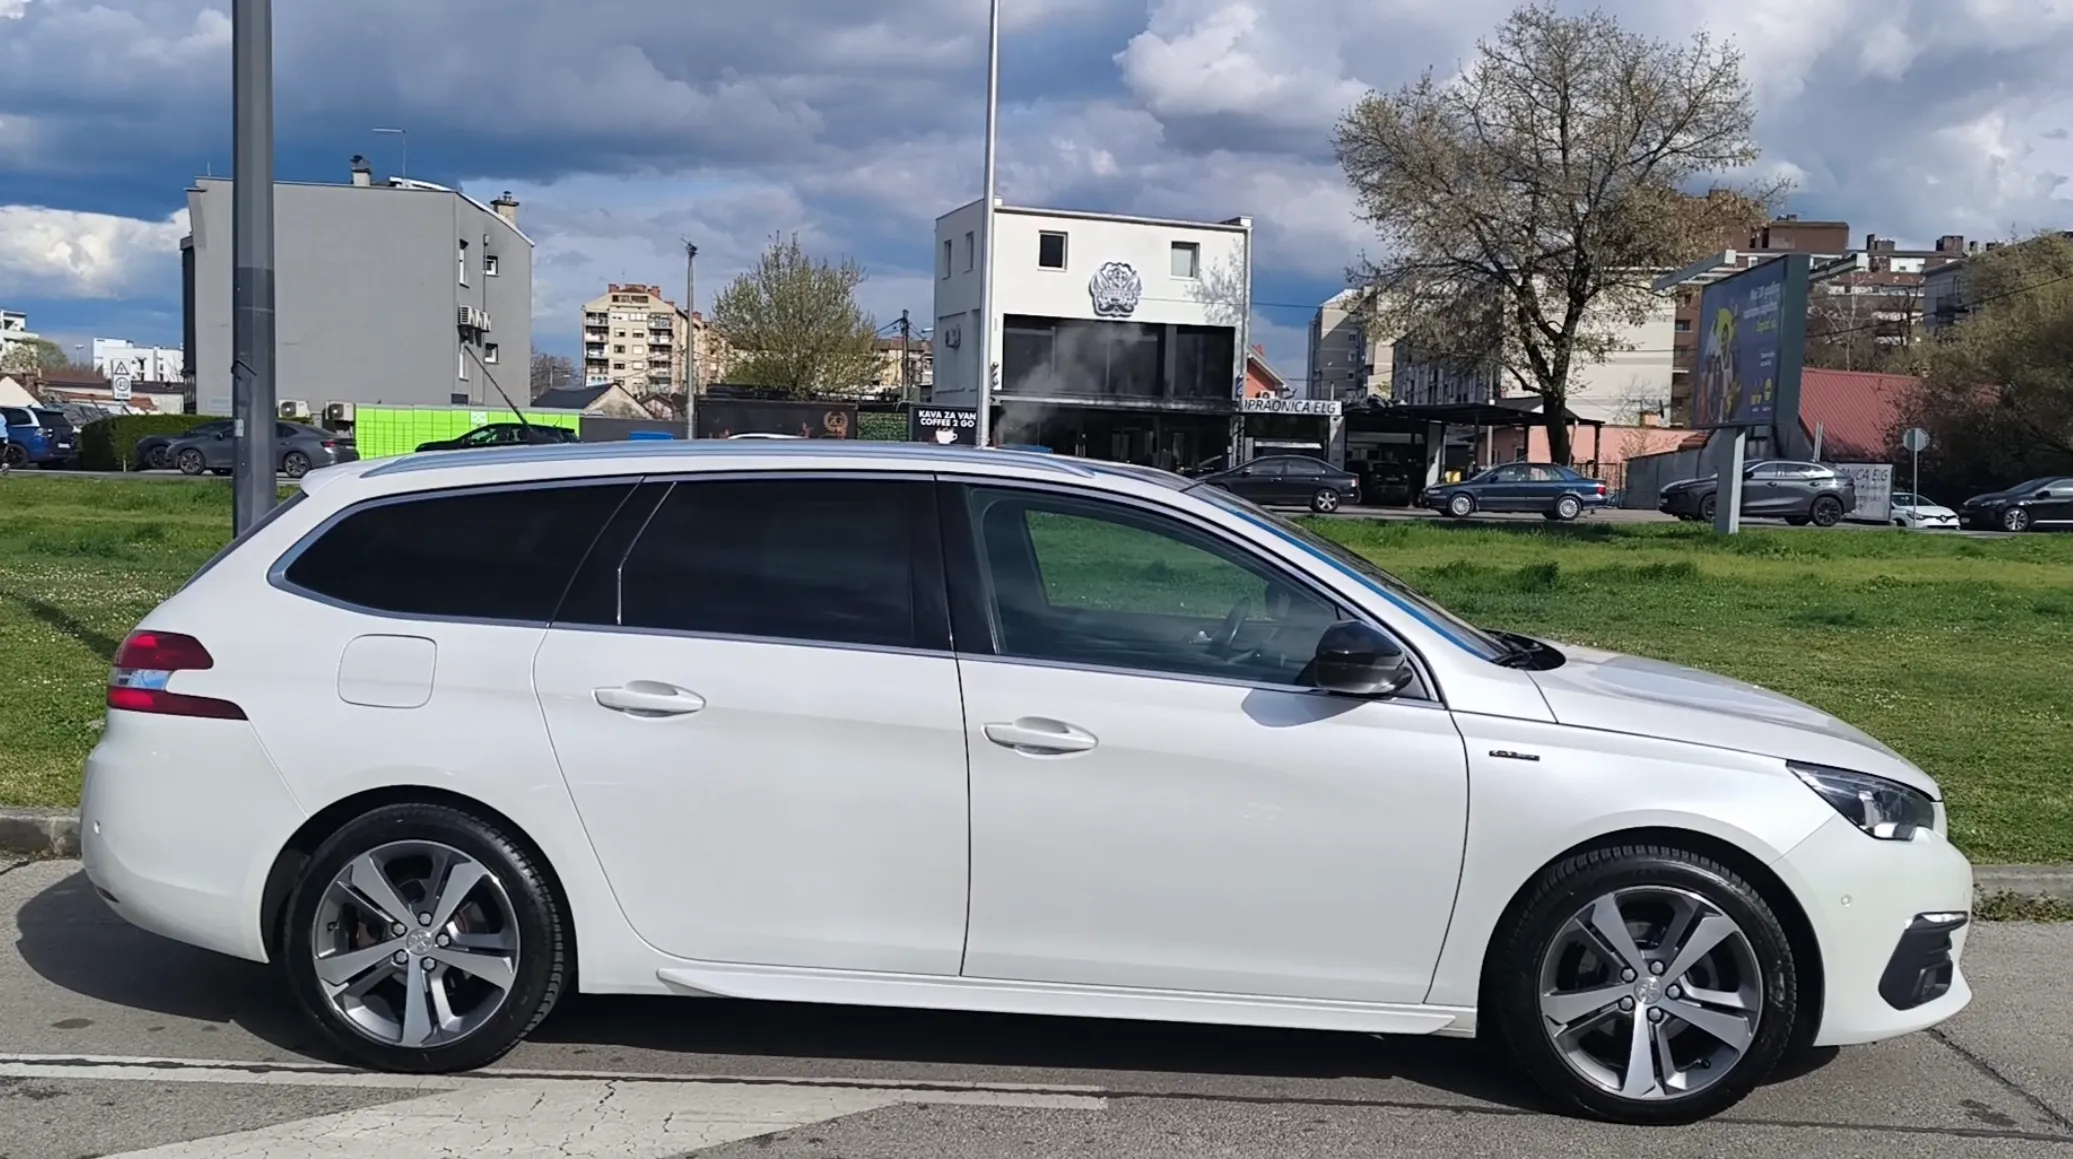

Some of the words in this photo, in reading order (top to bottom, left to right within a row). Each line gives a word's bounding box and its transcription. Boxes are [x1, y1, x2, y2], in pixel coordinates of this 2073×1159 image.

[918, 410, 942, 418] KAVA
[944, 411, 956, 419] ZA
[957, 411, 977, 420] VAN
[920, 418, 951, 427] COFFEE
[952, 419, 959, 427] 2
[960, 419, 975, 428] GO
